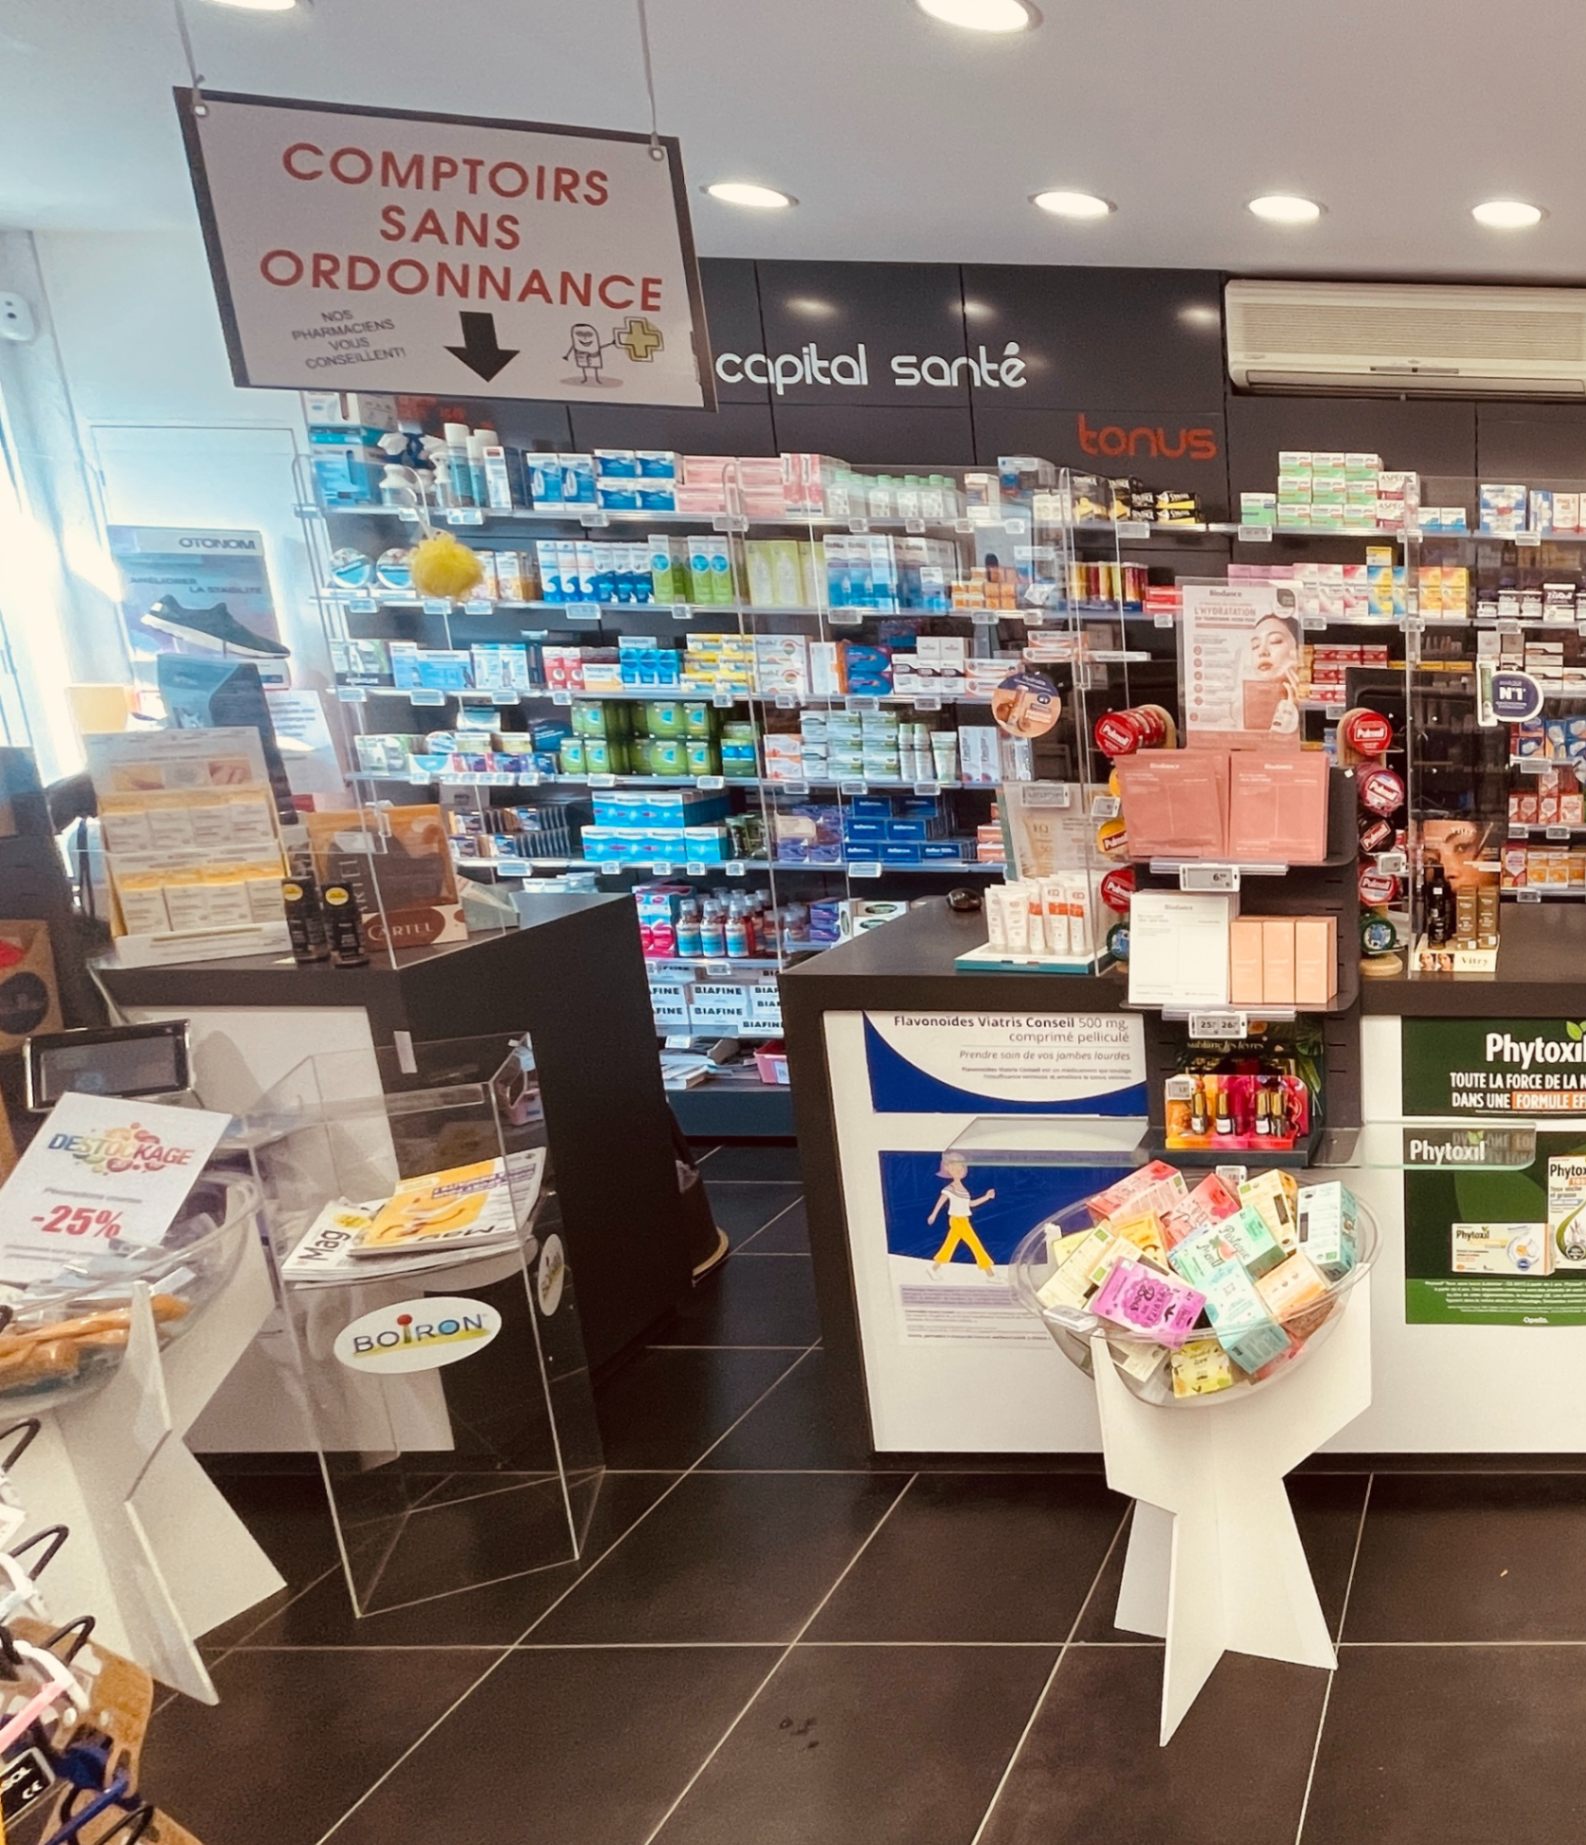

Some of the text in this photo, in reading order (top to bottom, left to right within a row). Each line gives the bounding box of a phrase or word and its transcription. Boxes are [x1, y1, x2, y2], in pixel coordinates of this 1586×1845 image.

[283, 142, 609, 206] COMPTOIRS
[379, 204, 521, 251] SANS
[260, 249, 662, 312] ORDONNANCE
[321, 310, 354, 322] NOS
[291, 318, 396, 341] PHARMACIENS
[328, 337, 370, 351] VOUS
[305, 347, 407, 369] CONSEILLENT!
[715, 341, 1028, 395] capital santé
[1077, 413, 1218, 460] tonus
[650, 987, 680, 995] FINE
[695, 987, 742, 996] BIAFINE
[694, 1007, 743, 1016] BIAFINE
[743, 1021, 783, 1029] BIAFIN
[894, 1016, 974, 1028] Flavonoïdes
[978, 1017, 1022, 1028] Viatris
[1026, 1017, 1075, 1028] Conseil
[1079, 1018, 1102, 1028] 500
[1009, 1031, 1130, 1044] comprimé pelliculé
[959, 1050, 1131, 1062] Prendre soin de vos jambes lourdes
[1450, 1073, 1487, 1088] TOUTE
[1489, 1074, 1504, 1089] LA
[1506, 1074, 1543, 1089] FORCE
[1545, 1074, 1561, 1089] DE
[1563, 1074, 1578, 1089] LA
[1452, 1093, 1484, 1108] DANS
[1487, 1093, 1510, 1108] UNE
[1516, 1094, 1569, 1108] FORMULE
[48, 1133, 195, 1166] DESTOCKAGE
[1410, 1139, 1485, 1165] Phytoxil
[32, 1205, 123, 1239] -25%
[1456, 1229, 1490, 1241] Phytoxil
[300, 1228, 351, 1261] Mag
